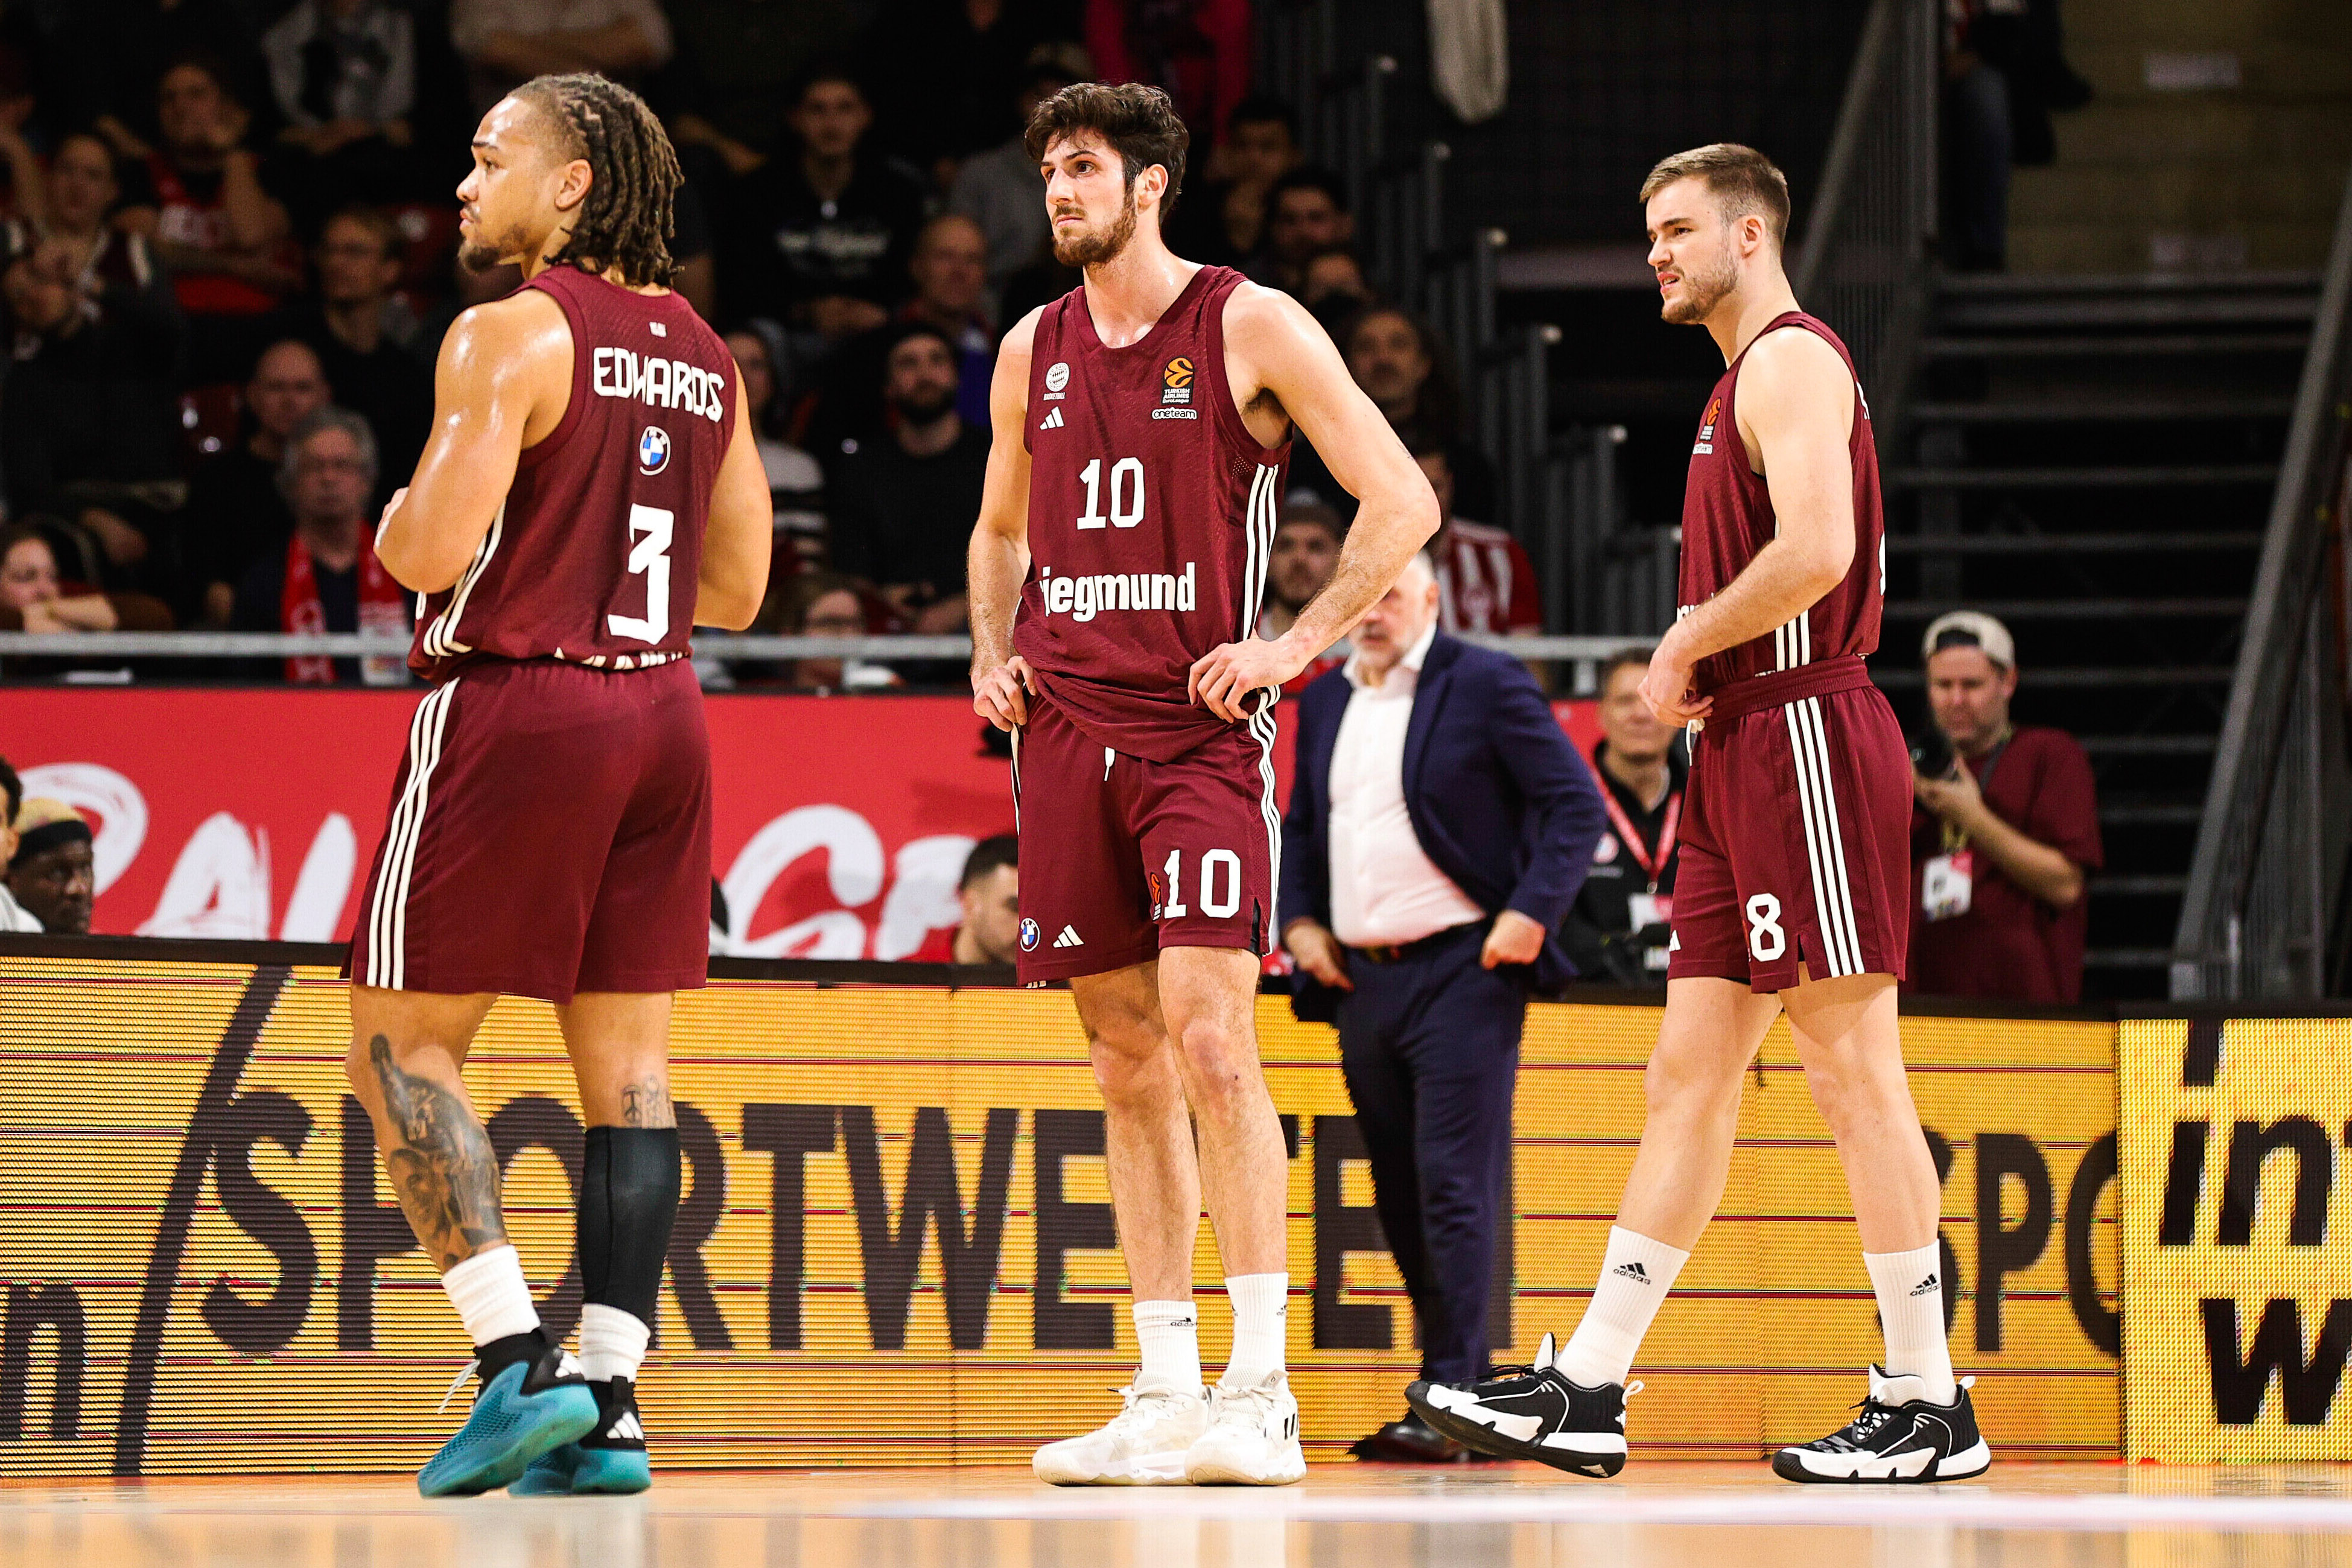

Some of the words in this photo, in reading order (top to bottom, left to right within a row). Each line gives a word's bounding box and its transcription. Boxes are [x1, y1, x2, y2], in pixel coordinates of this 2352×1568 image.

[594, 347, 725, 422] EDWARDS
[1154, 409, 1195, 418] oneteam
[1077, 457, 1145, 530] 10
[608, 503, 675, 646] 3
[1039, 562, 1195, 622] iegmund
[1163, 848, 1241, 919] 10
[1746, 893, 1786, 962] 8
[1613, 1268, 1651, 1285] adidas
